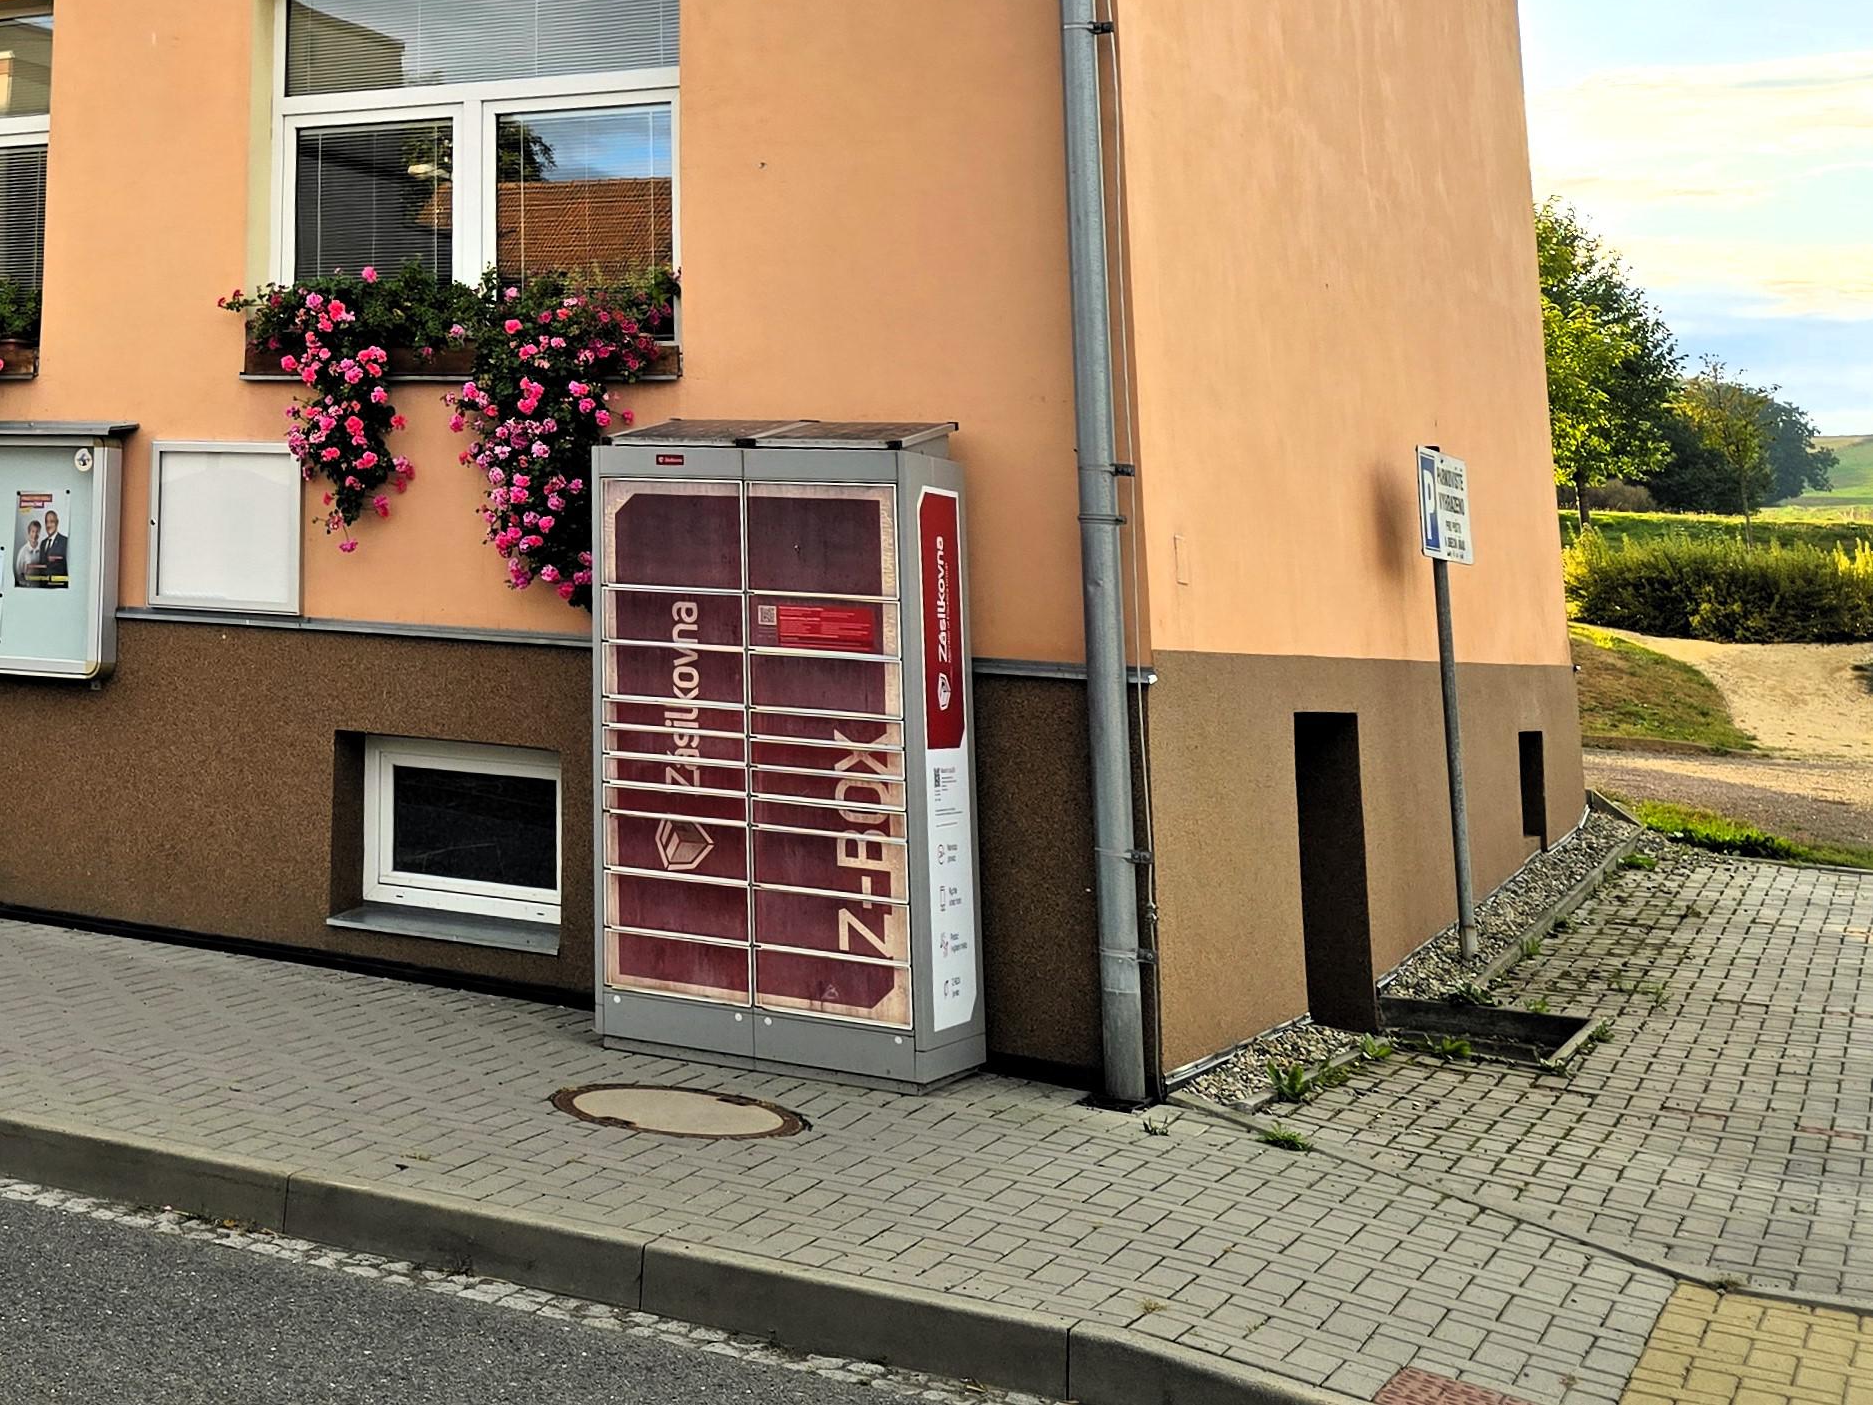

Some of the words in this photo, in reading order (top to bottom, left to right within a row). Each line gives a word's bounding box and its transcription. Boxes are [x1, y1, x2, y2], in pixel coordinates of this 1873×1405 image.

[1423, 469, 1436, 541] P
[936, 535, 948, 663] Zásilkovna
[664, 600, 700, 797] Zásilkovna
[833, 728, 894, 960] Z-BOX
